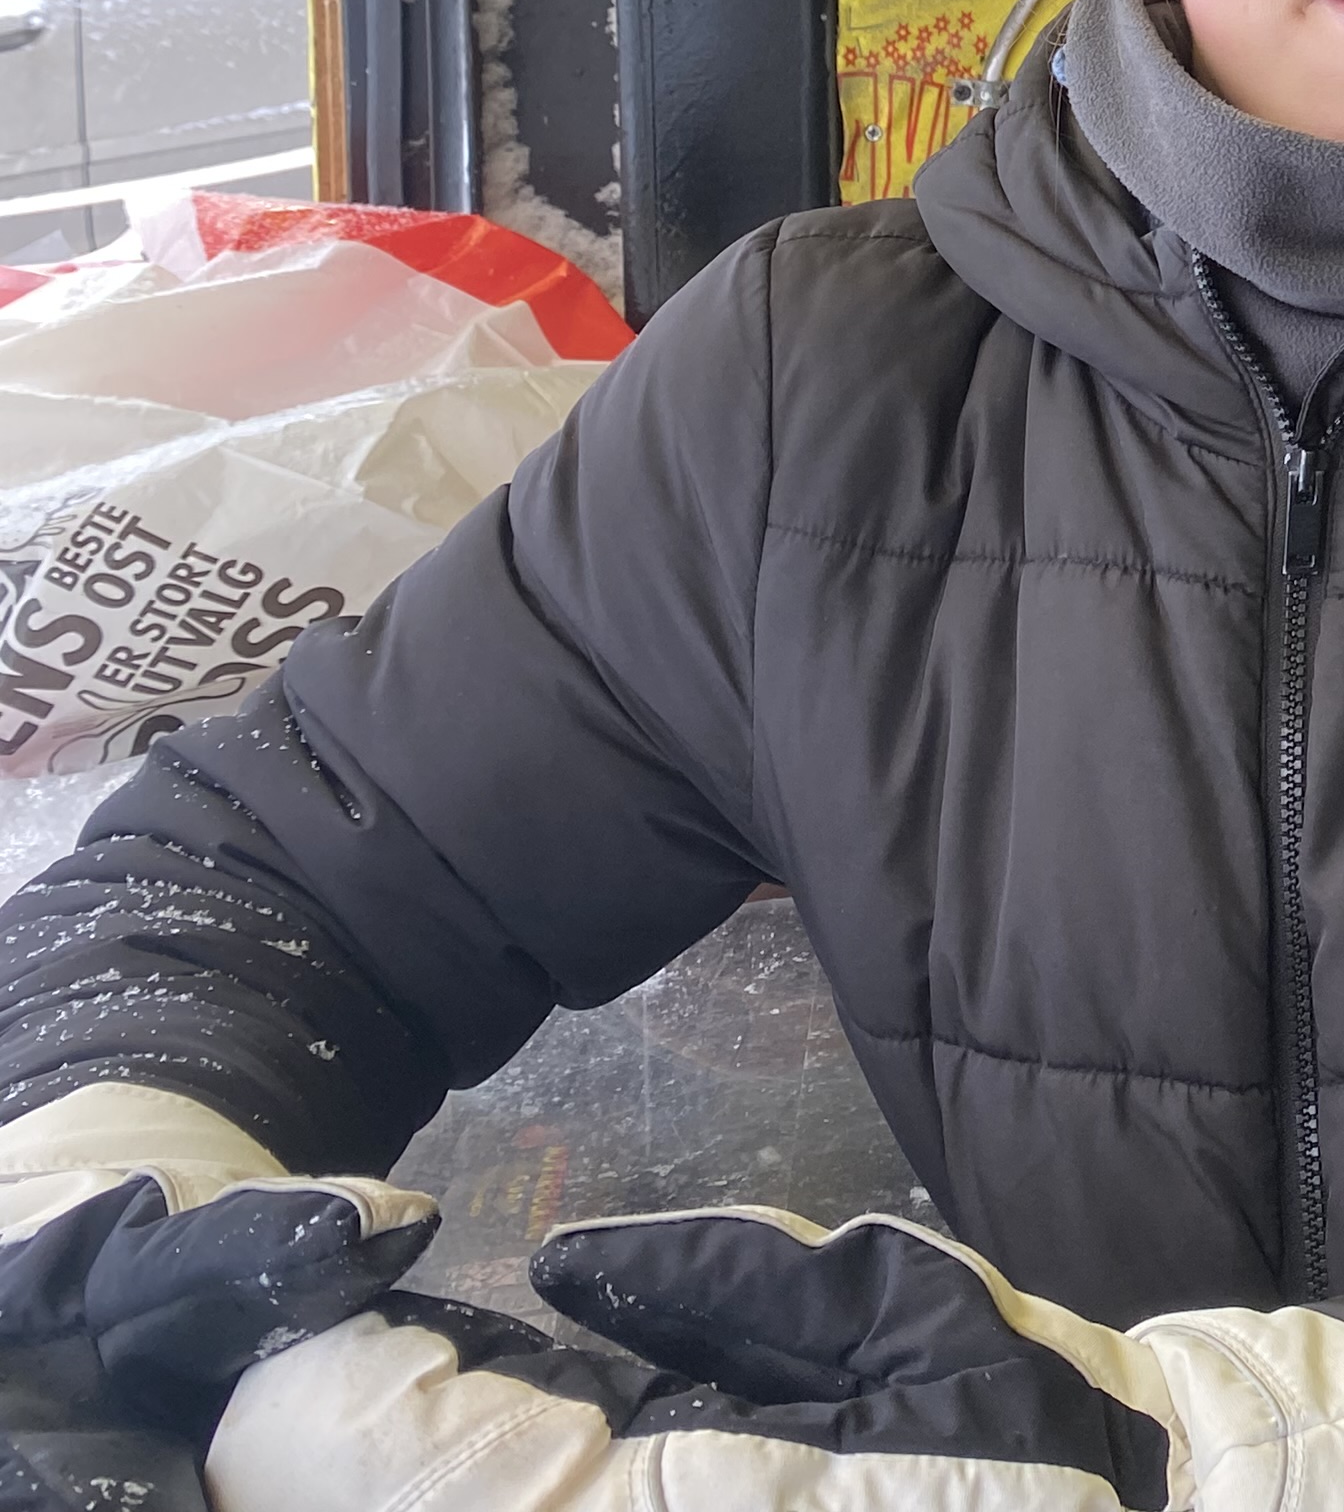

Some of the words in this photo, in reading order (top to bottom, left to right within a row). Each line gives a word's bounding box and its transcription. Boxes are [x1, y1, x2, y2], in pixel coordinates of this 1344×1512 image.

[44, 501, 130, 591] BESTE
[82, 515, 173, 609] OST
[92, 645, 151, 689] ER
[129, 540, 220, 643] STORT
[131, 558, 265, 696] UTVALG
